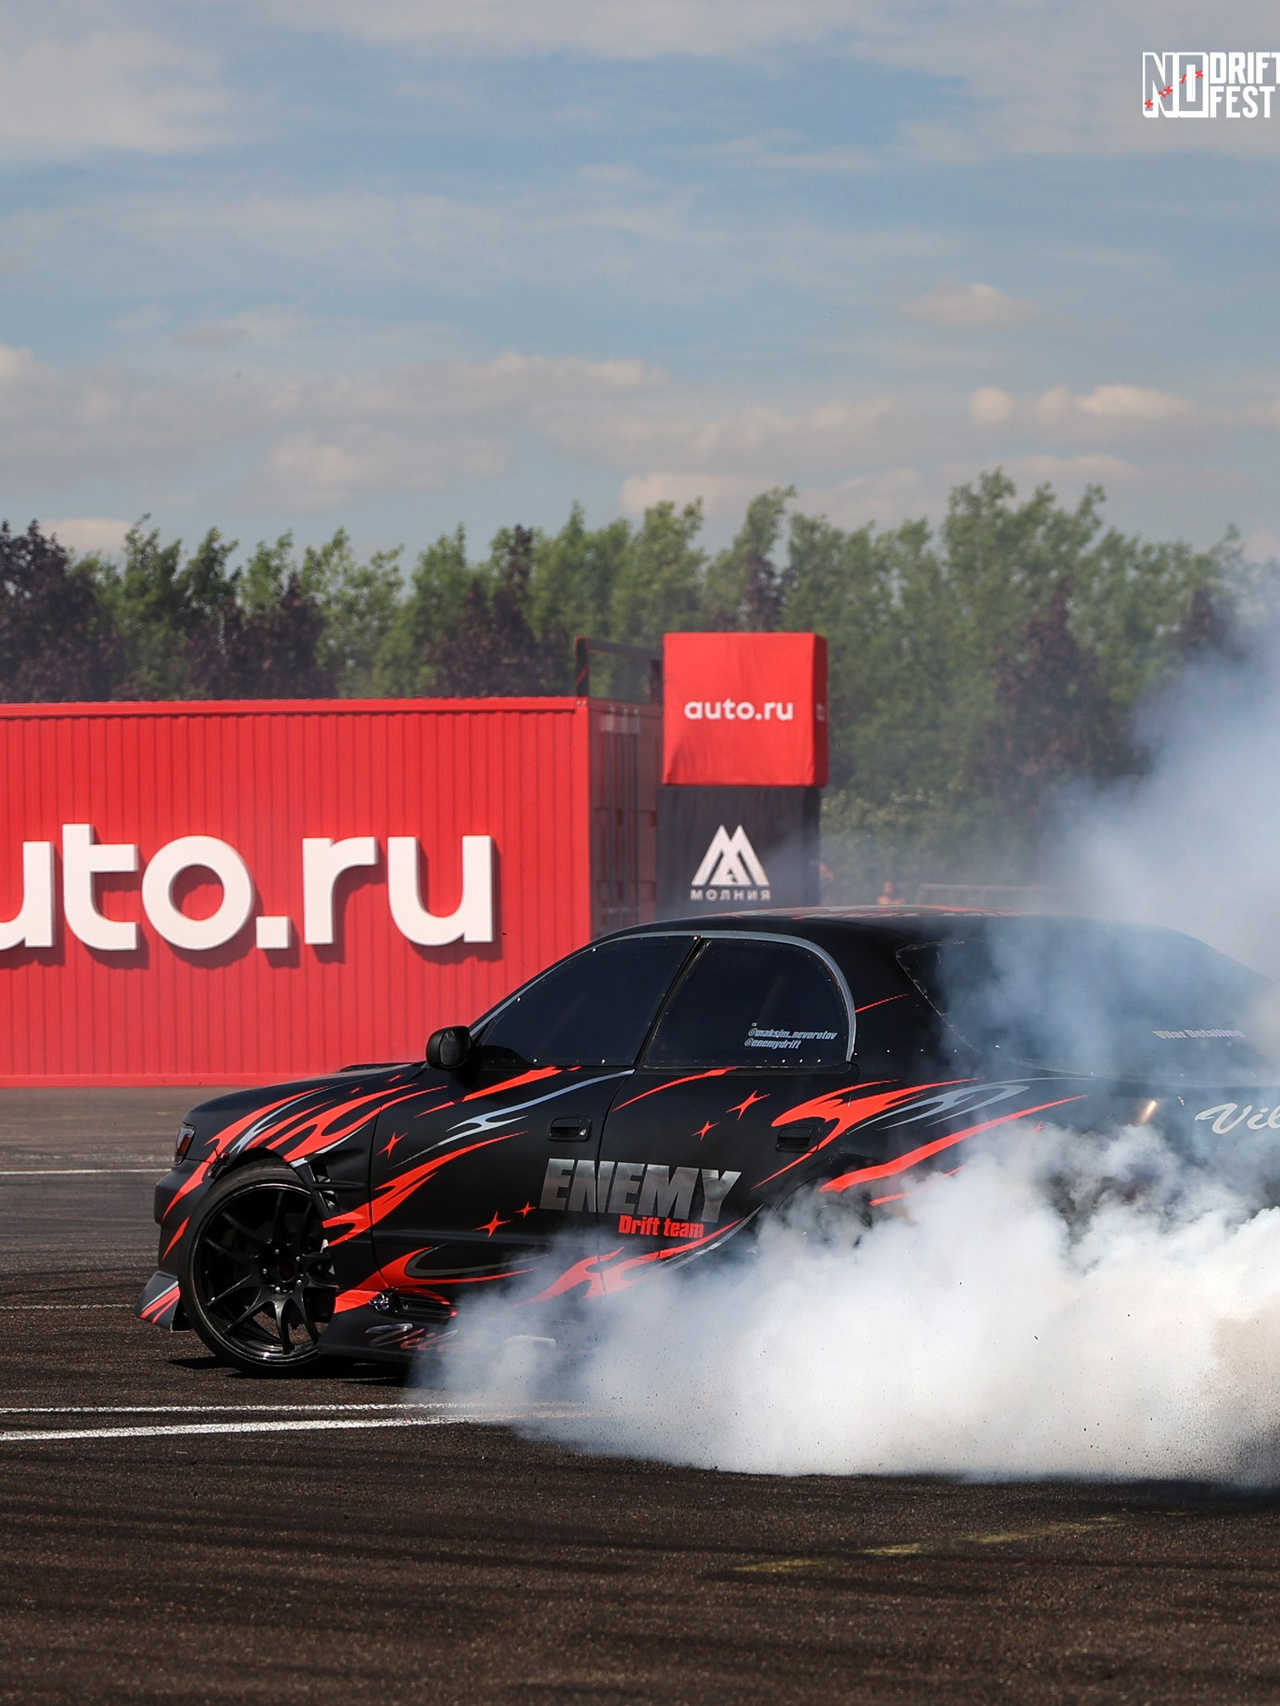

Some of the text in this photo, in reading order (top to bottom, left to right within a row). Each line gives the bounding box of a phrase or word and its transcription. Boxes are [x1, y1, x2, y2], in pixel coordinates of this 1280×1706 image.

[684, 698, 794, 720] auto.ru
[690, 889, 771, 901] МОЛНИЯ
[539, 1158, 742, 1223] ENEMY
[618, 1214, 705, 1239] Drift team
